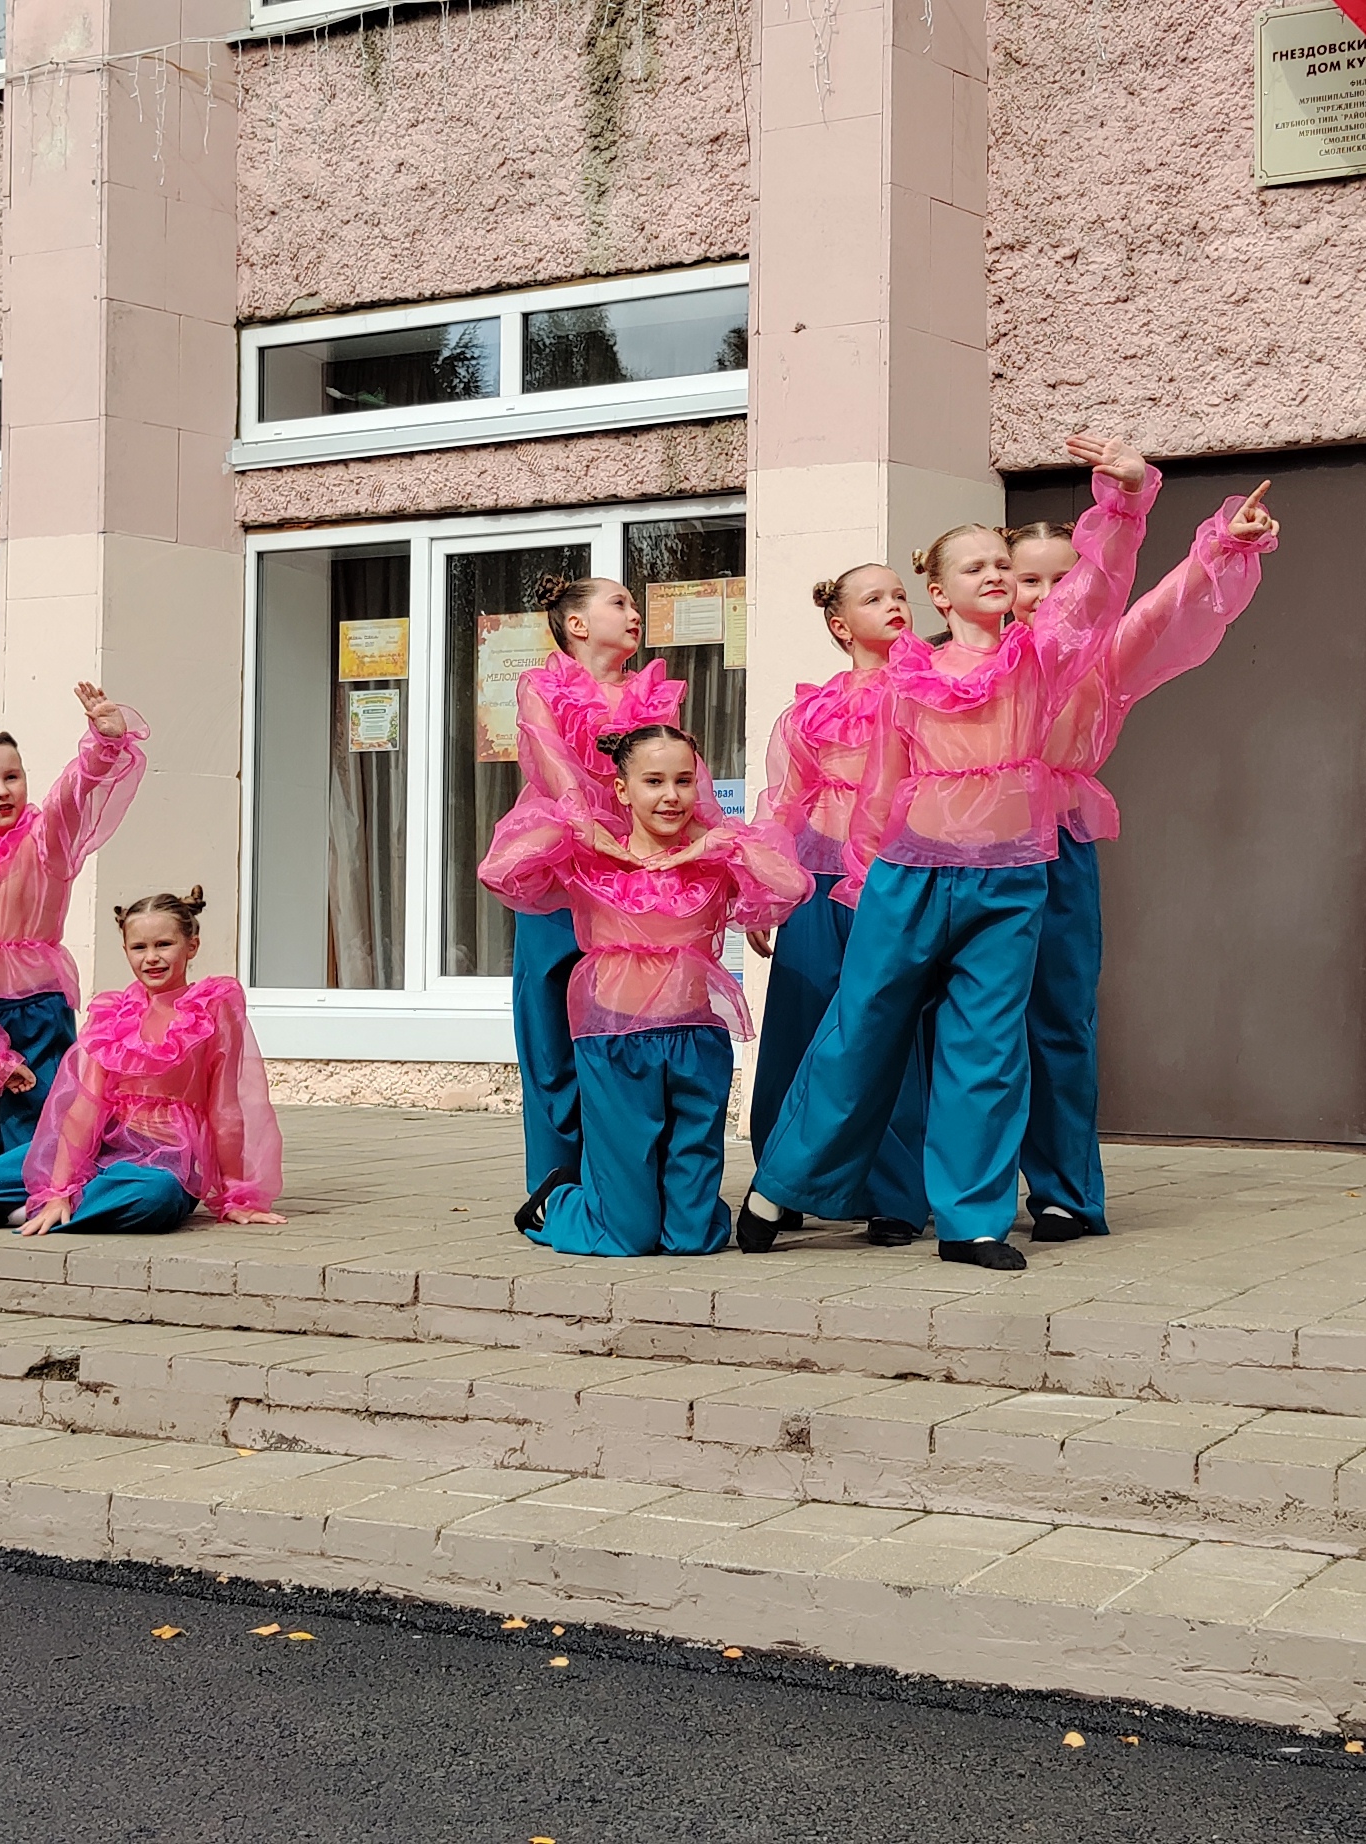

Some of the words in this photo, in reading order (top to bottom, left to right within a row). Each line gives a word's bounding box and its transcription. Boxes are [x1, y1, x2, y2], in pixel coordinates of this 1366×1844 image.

[1306, 61, 1341, 77] ДОМ
[1275, 117, 1315, 130] КЛУБНОГО
[1317, 114, 1339, 124] ТИПА
